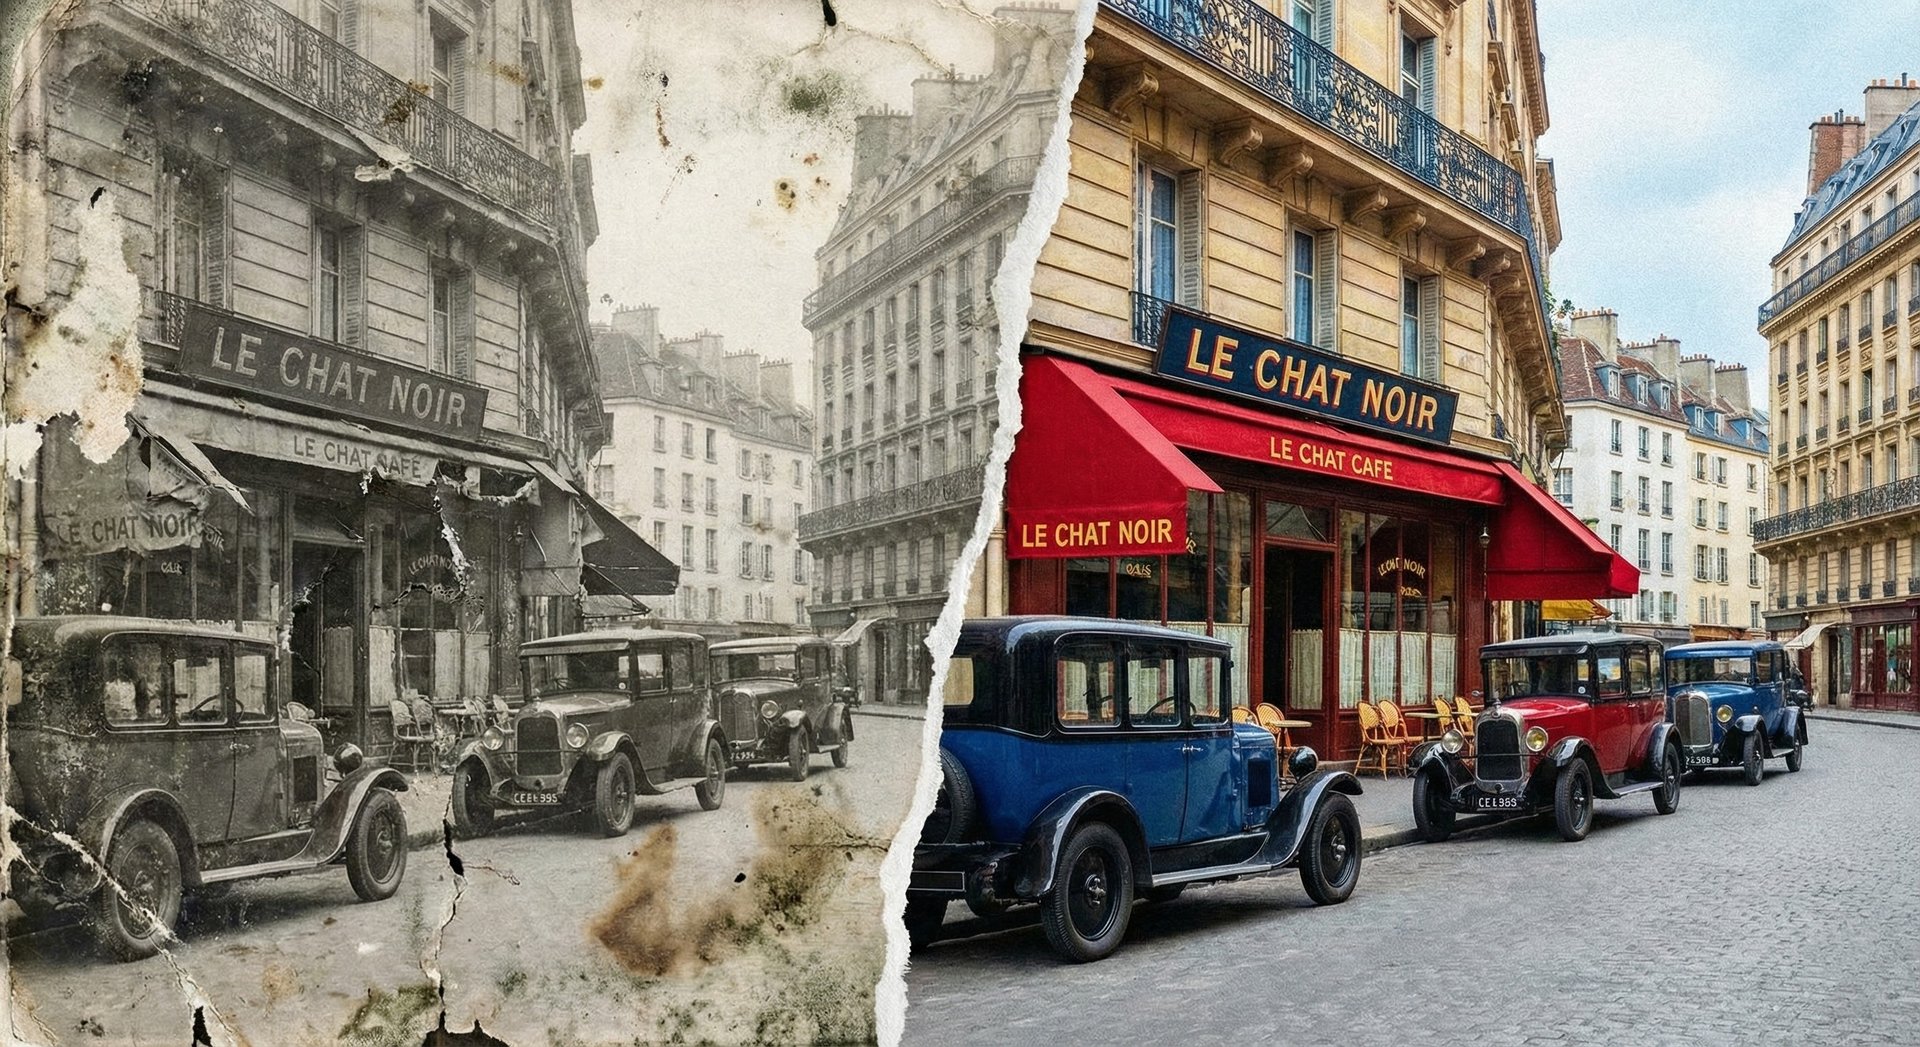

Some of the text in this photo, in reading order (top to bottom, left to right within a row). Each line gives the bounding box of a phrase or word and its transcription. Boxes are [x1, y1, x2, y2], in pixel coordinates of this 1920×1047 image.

[211, 326, 466, 428] LE CHAT NOIR
[1185, 328, 1439, 432] LE CHAT NOIR
[294, 435, 316, 458] LE
[323, 441, 372, 470] CHAT
[1270, 436, 1394, 481] LE CHAT CAFE
[56, 512, 202, 546] LE CHAT NOIR
[1022, 519, 1173, 548] LE CHAT NOIR
[1403, 558, 1426, 580] NOIR
